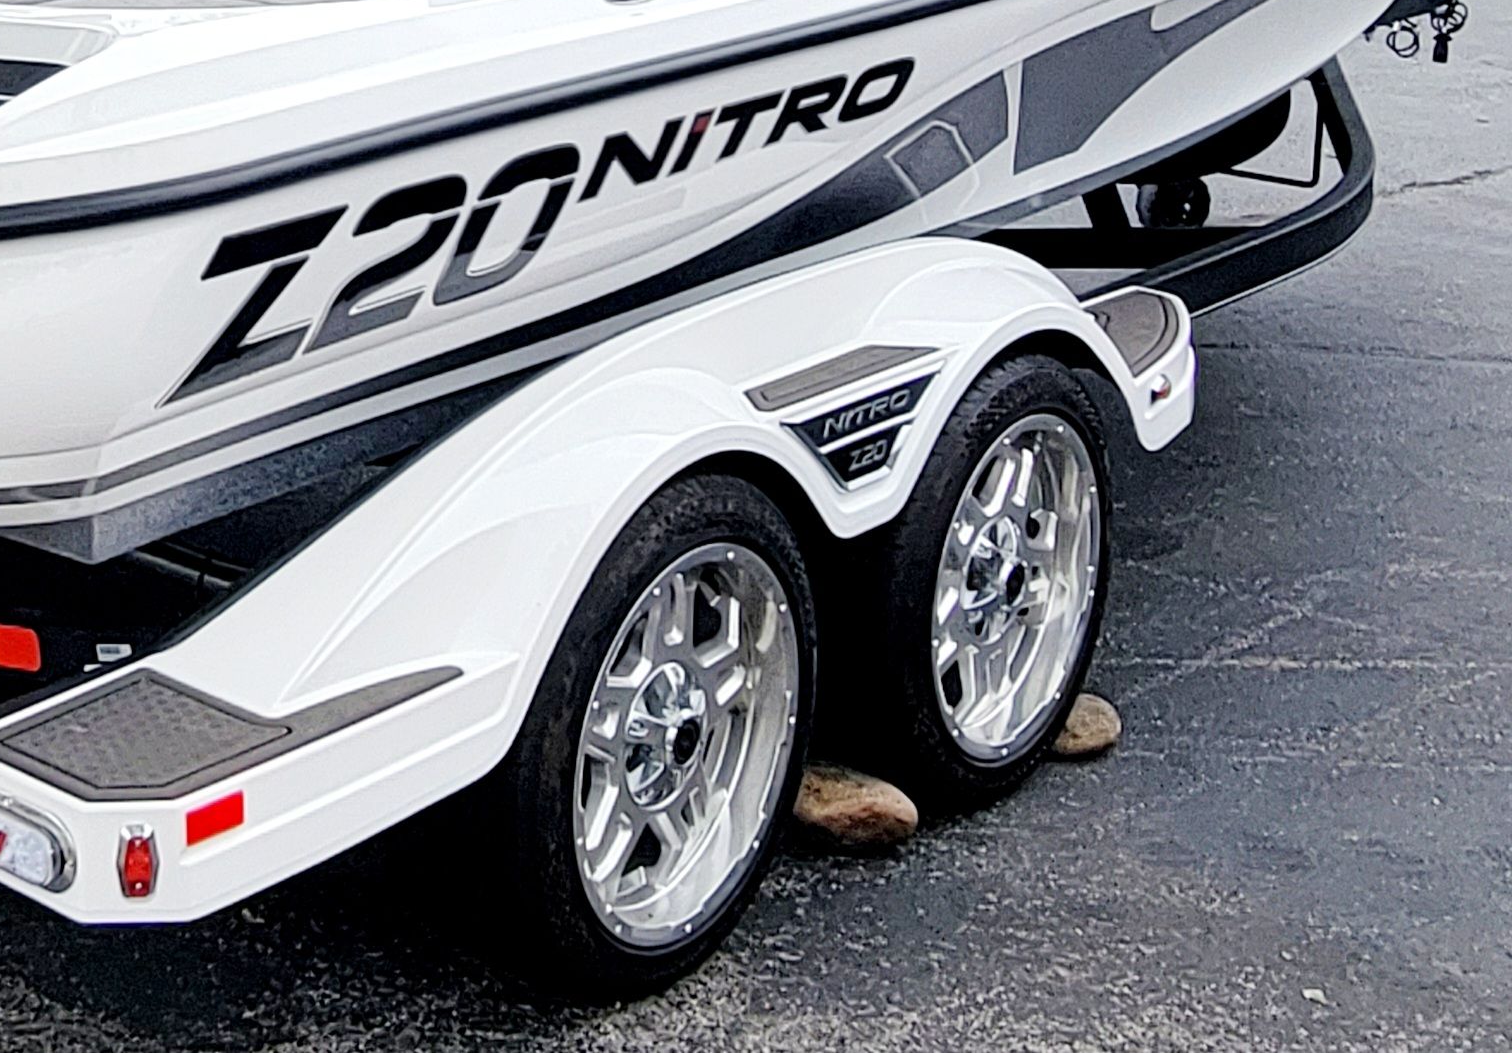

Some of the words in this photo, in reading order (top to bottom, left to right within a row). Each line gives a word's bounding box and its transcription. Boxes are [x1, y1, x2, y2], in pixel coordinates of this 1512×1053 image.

[155, 143, 580, 409] Z20
[579, 57, 915, 203] NITRO
[822, 388, 911, 438] NITRO
[848, 439, 888, 472] Z20
